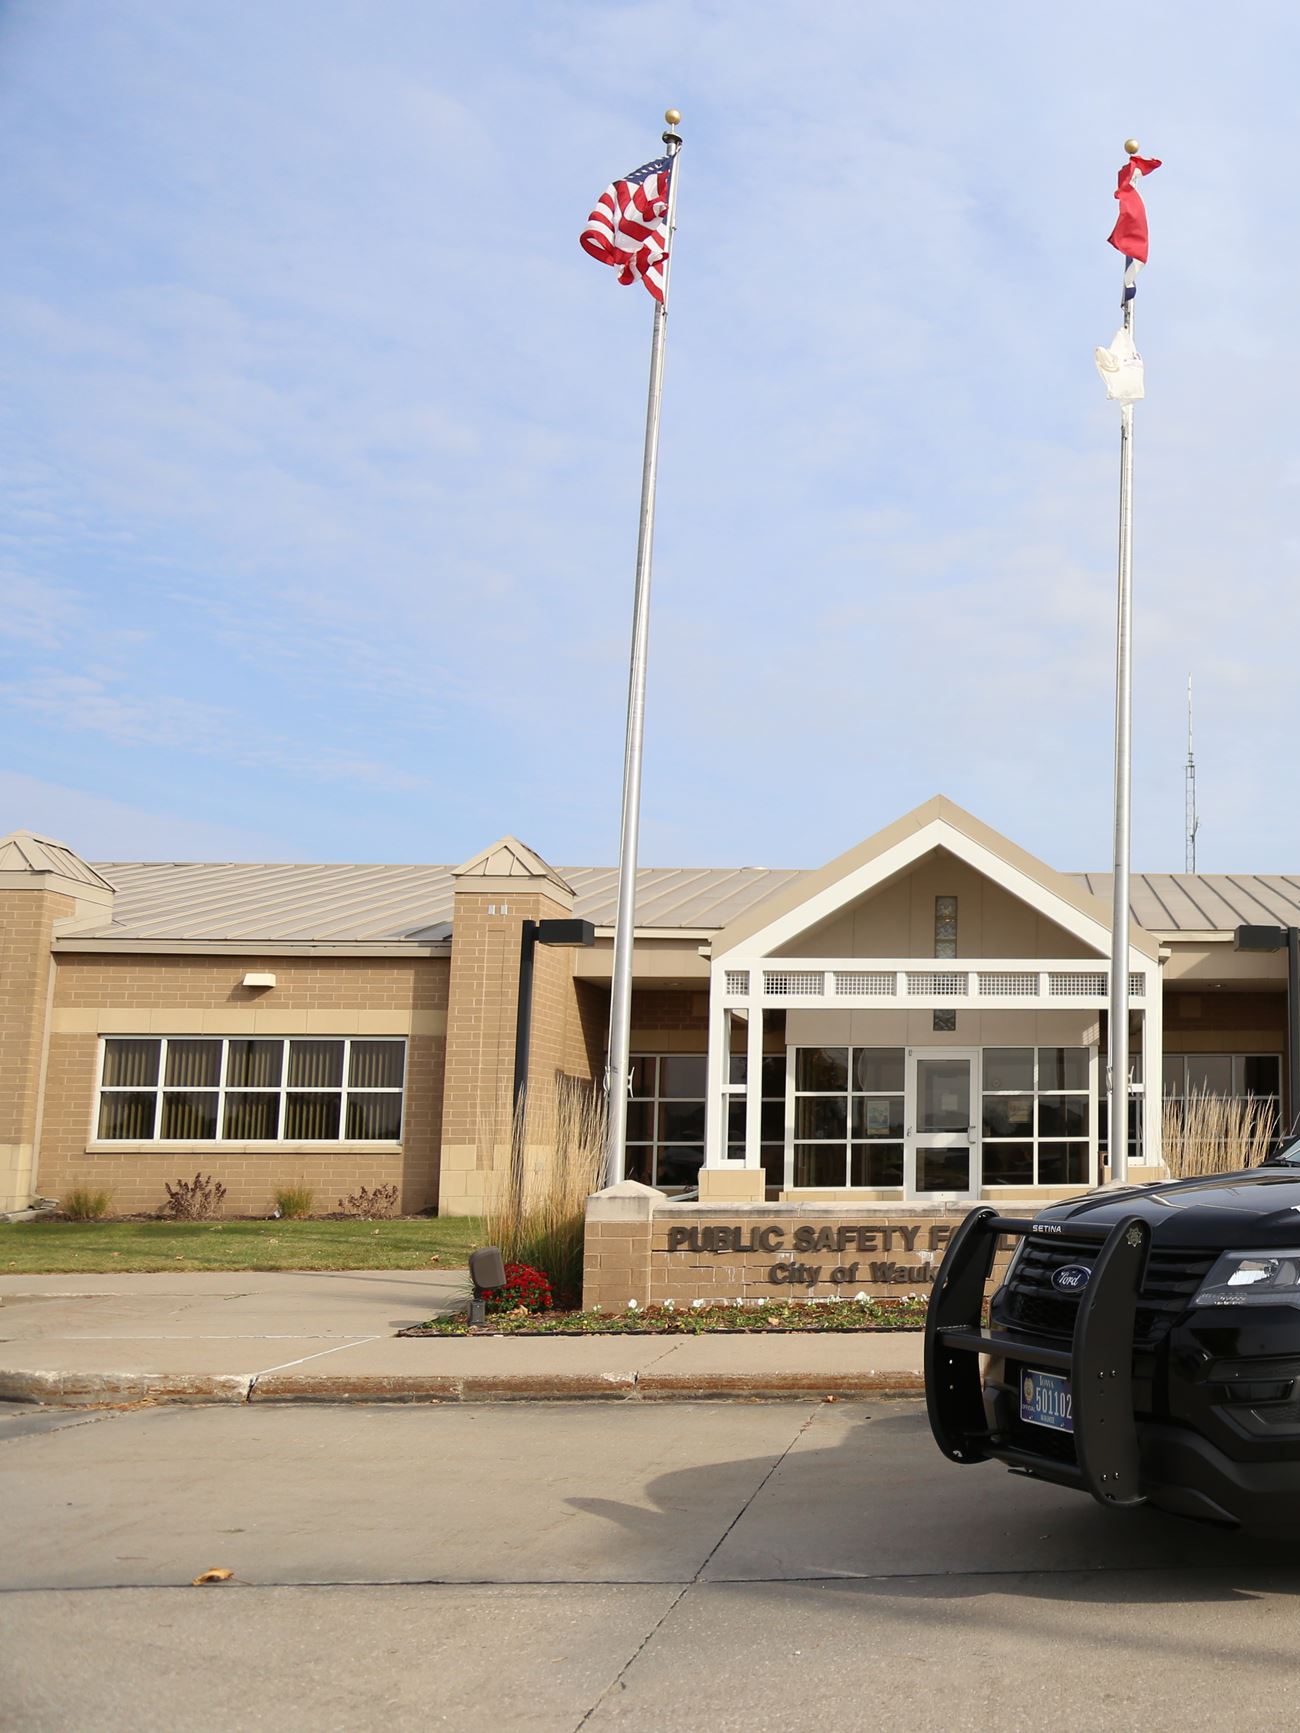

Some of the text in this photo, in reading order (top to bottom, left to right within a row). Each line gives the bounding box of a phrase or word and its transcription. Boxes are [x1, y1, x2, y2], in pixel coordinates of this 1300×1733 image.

[667, 1225, 786, 1252] PUBLIC
[793, 1225, 921, 1252] SAFETY
[1032, 1224, 1062, 1233] SETINA
[769, 1261, 941, 1287] City of Wauk
[1058, 1271, 1081, 1286] Ford
[1035, 1386, 1073, 1420] 501102
